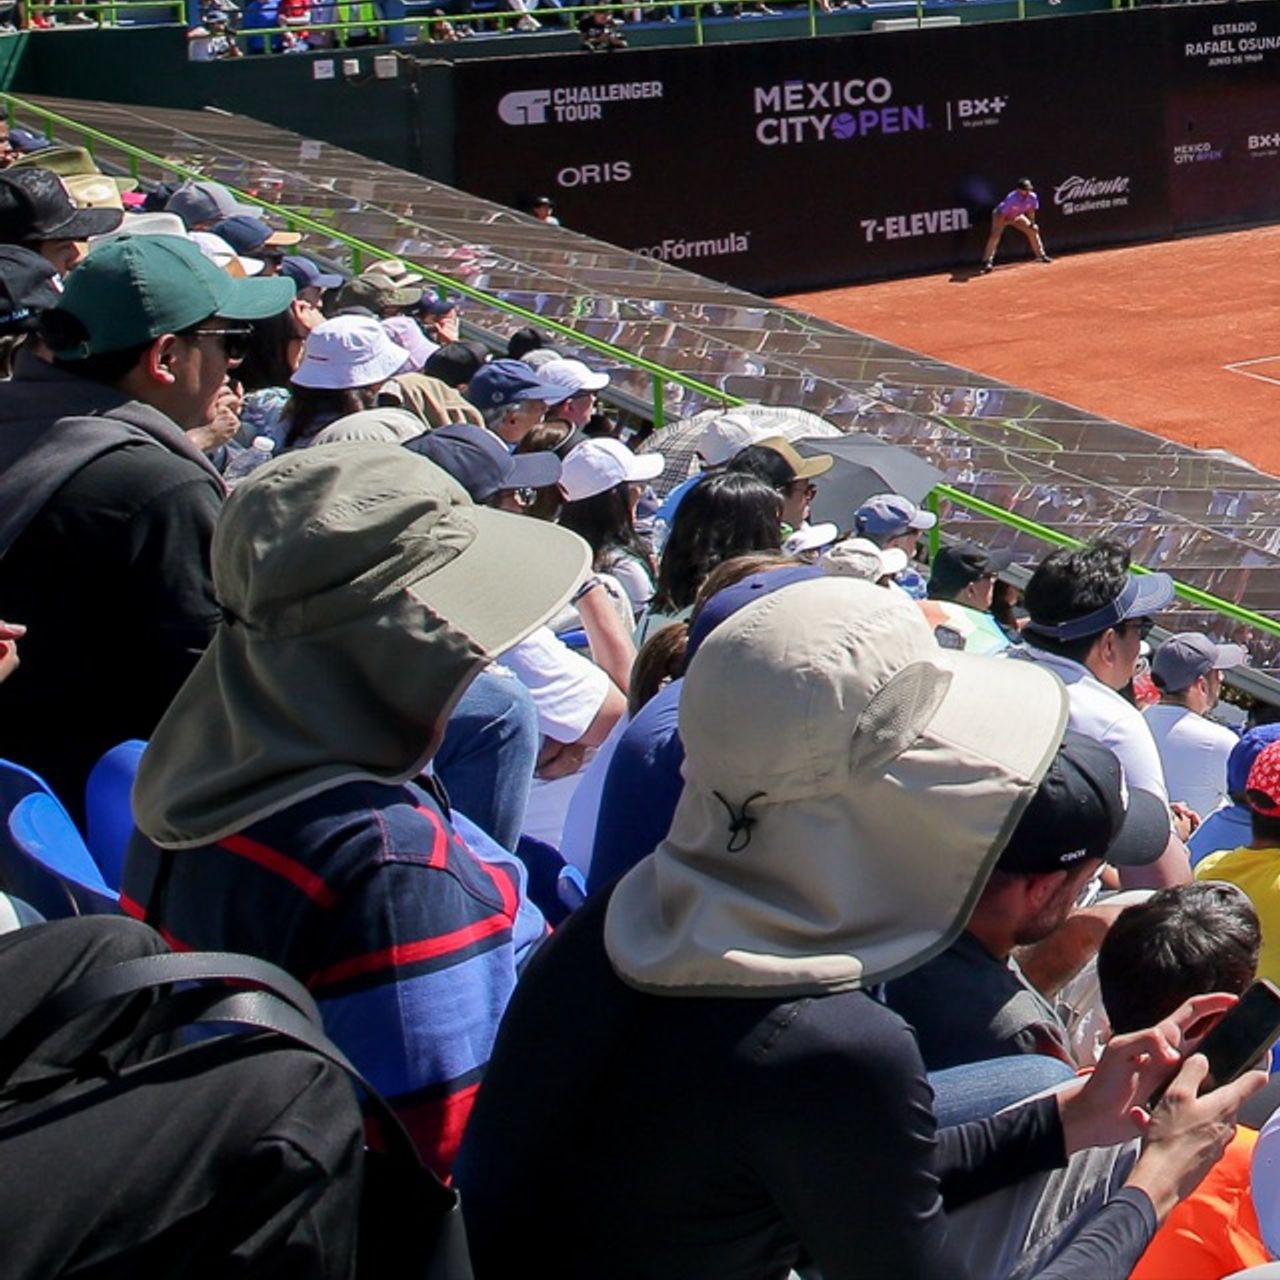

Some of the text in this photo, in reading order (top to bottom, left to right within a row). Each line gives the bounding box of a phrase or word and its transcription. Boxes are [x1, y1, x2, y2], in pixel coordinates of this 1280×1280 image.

[1212, 21, 1258, 36] ESTADIO
[1184, 40, 1236, 57] RAFAEL
[552, 81, 664, 105] CHALLENGER
[753, 76, 893, 114] MEXICO
[553, 103, 602, 122] TOUR
[1173, 141, 1212, 155] MEXICO
[557, 160, 632, 188] ORIS
[1053, 175, 1129, 206] Caliente
